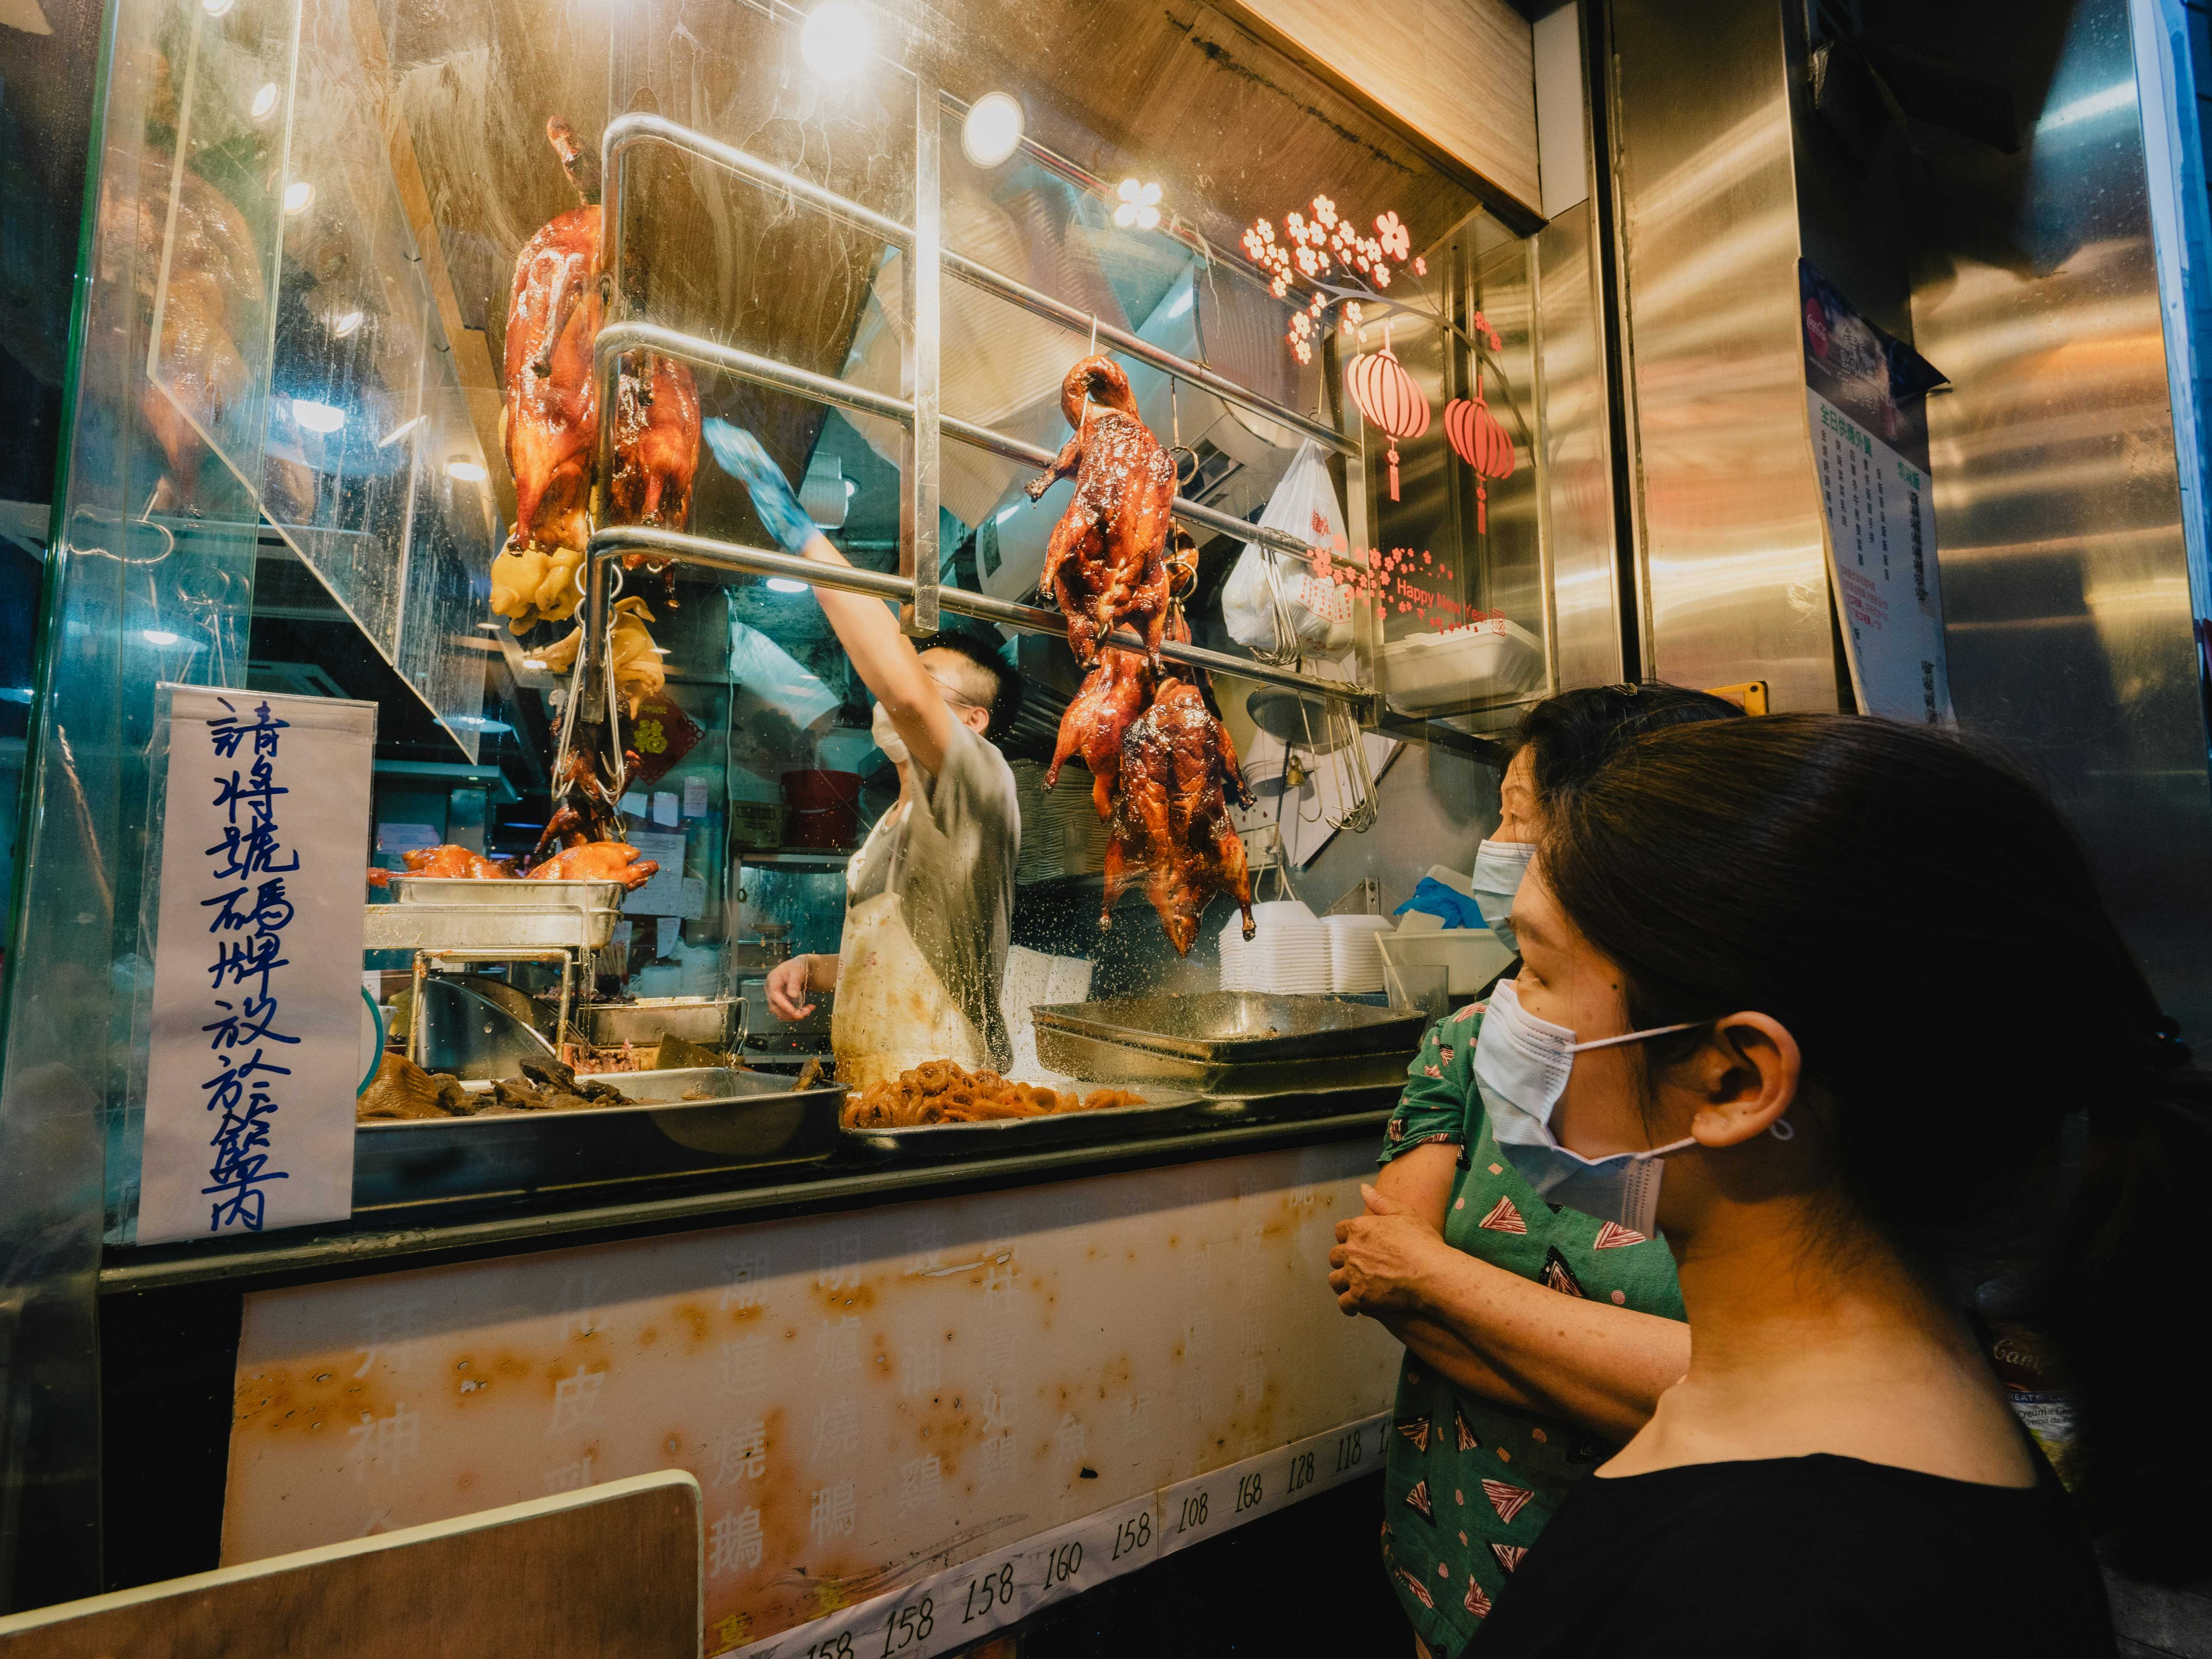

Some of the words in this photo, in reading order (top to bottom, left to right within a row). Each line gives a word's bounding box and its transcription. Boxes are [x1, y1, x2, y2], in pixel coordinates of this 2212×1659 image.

[1397, 577, 1434, 608] Happy
[1437, 592, 1461, 615] New
[1462, 599, 1489, 624] Year
[634, 719, 668, 754] 福
[2008, 1393, 2032, 1401] REAT
[2017, 1408, 2047, 1419] Cream
[1287, 1451, 1314, 1494] 128
[1336, 1429, 1362, 1473] 118
[1177, 1493, 1209, 1533] 108
[1235, 1473, 1263, 1513] 168
[1112, 1512, 1151, 1561] 158
[1042, 1540, 1083, 1591] 160
[961, 1563, 1014, 1625] 158
[880, 1597, 934, 1659] 158
